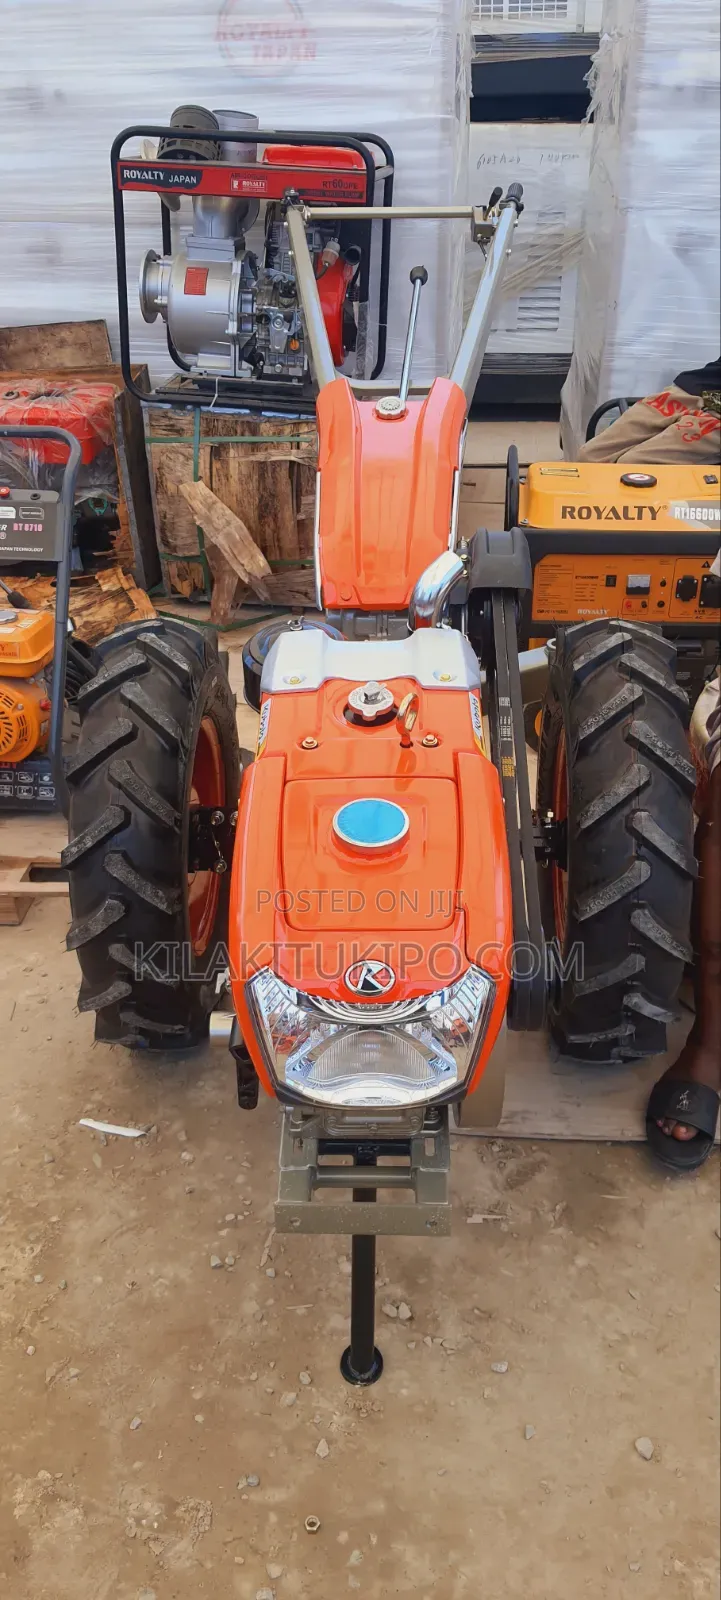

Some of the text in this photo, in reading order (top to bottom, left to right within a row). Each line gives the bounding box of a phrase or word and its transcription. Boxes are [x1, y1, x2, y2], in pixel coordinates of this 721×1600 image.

[123, 169, 197, 184] ROYALTY JAPAN
[561, 505, 661, 520] ROYALTY
[577, 608, 608, 616] ROYALTY
